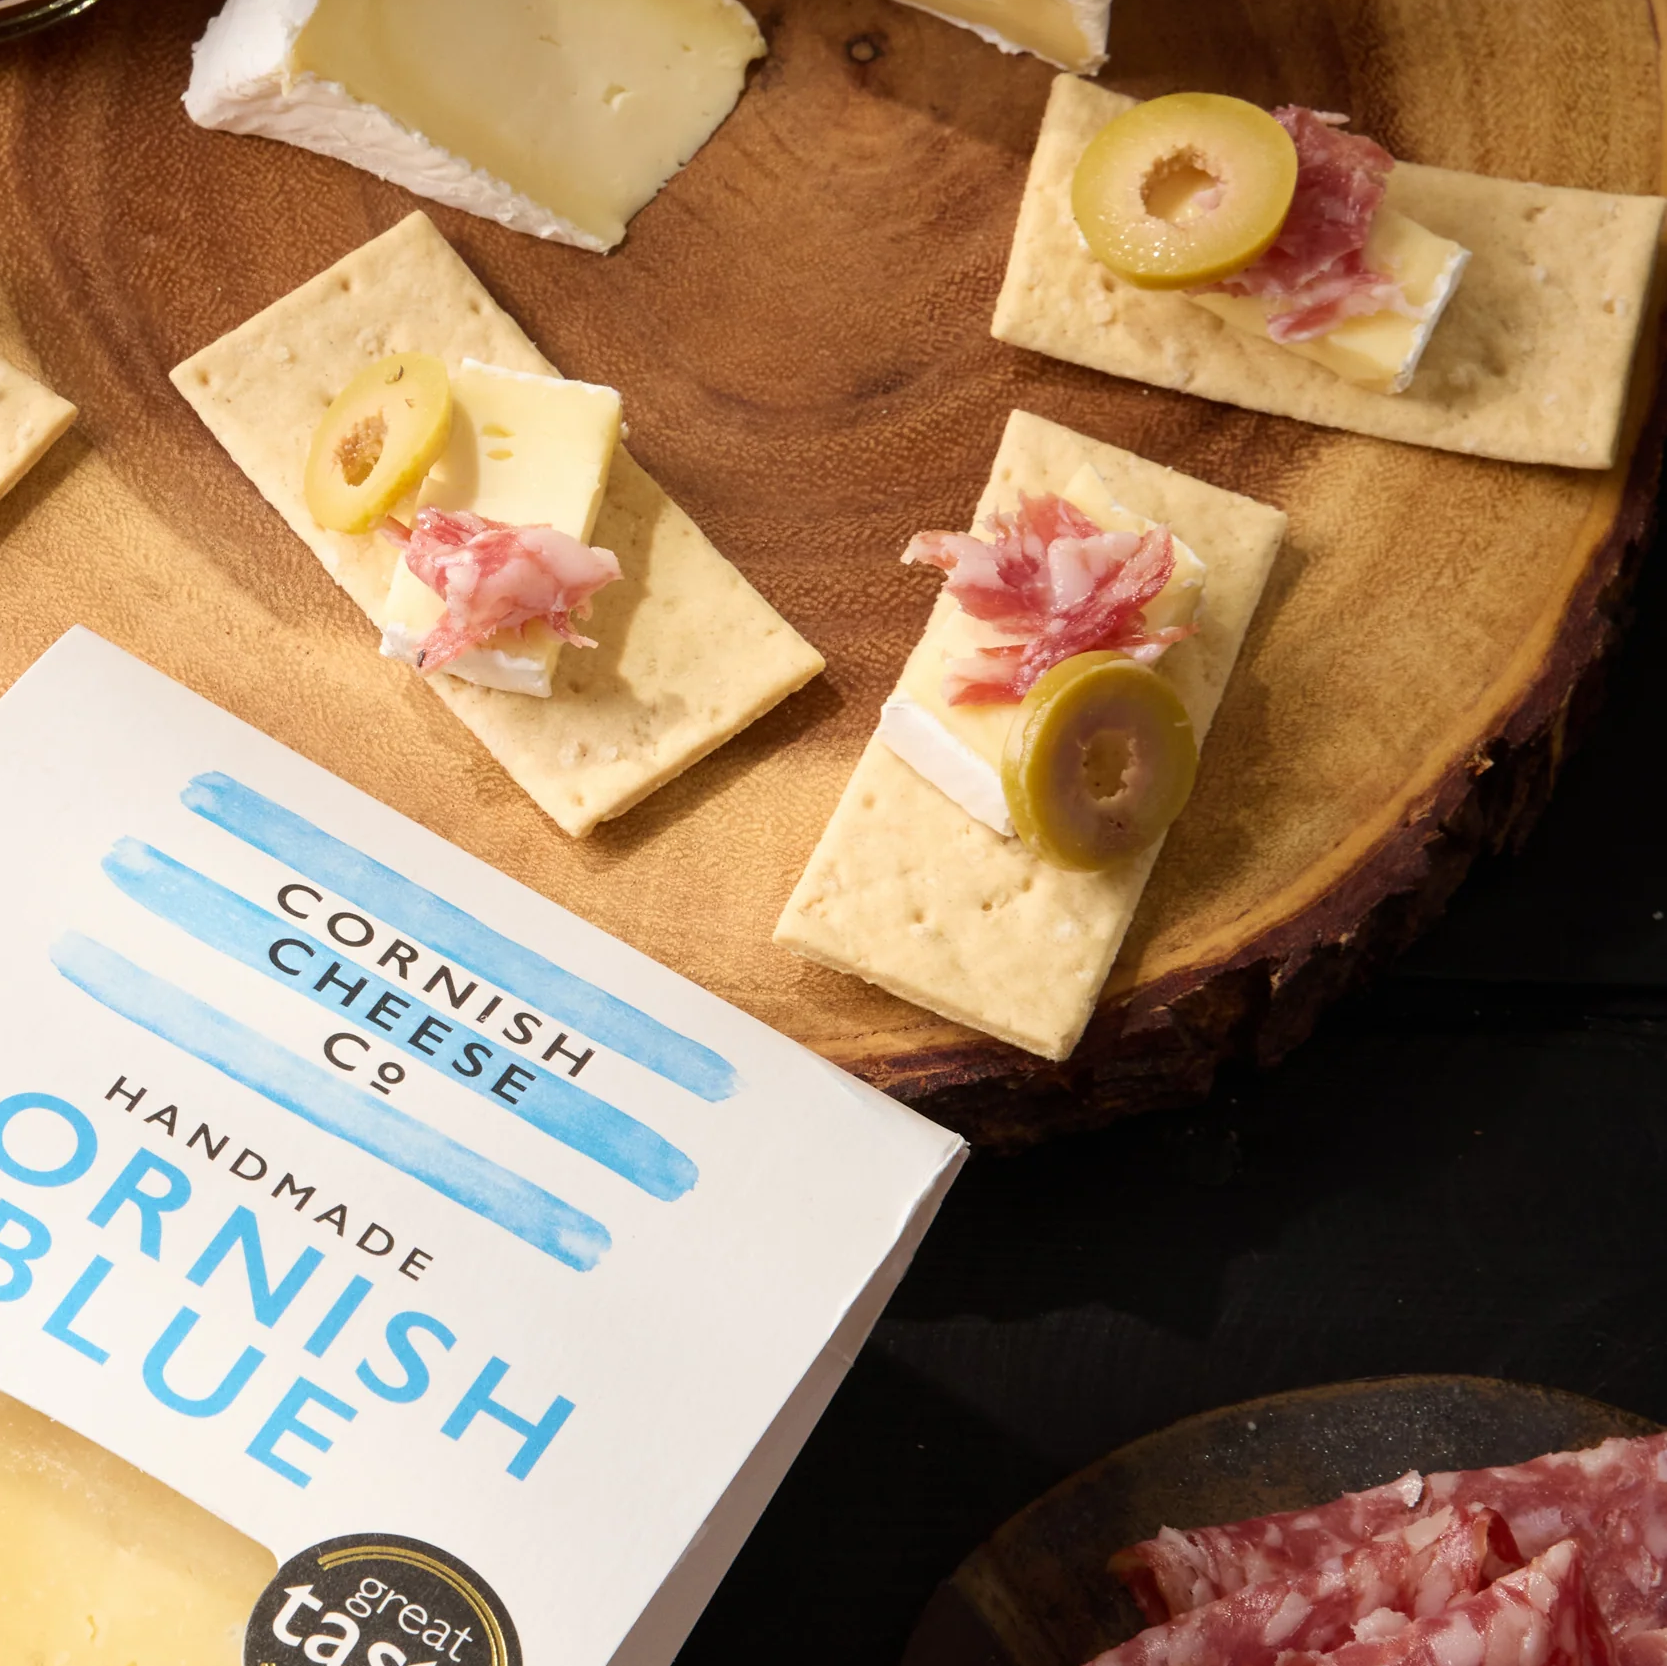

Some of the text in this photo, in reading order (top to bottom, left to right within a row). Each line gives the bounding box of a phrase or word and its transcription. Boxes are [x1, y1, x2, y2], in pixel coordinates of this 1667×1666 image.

[267, 937, 538, 1106] CHEESE
[276, 882, 597, 1079] CORNISH
[104, 1074, 435, 1282] HANDMADE
[344, 1577, 474, 1663] great
